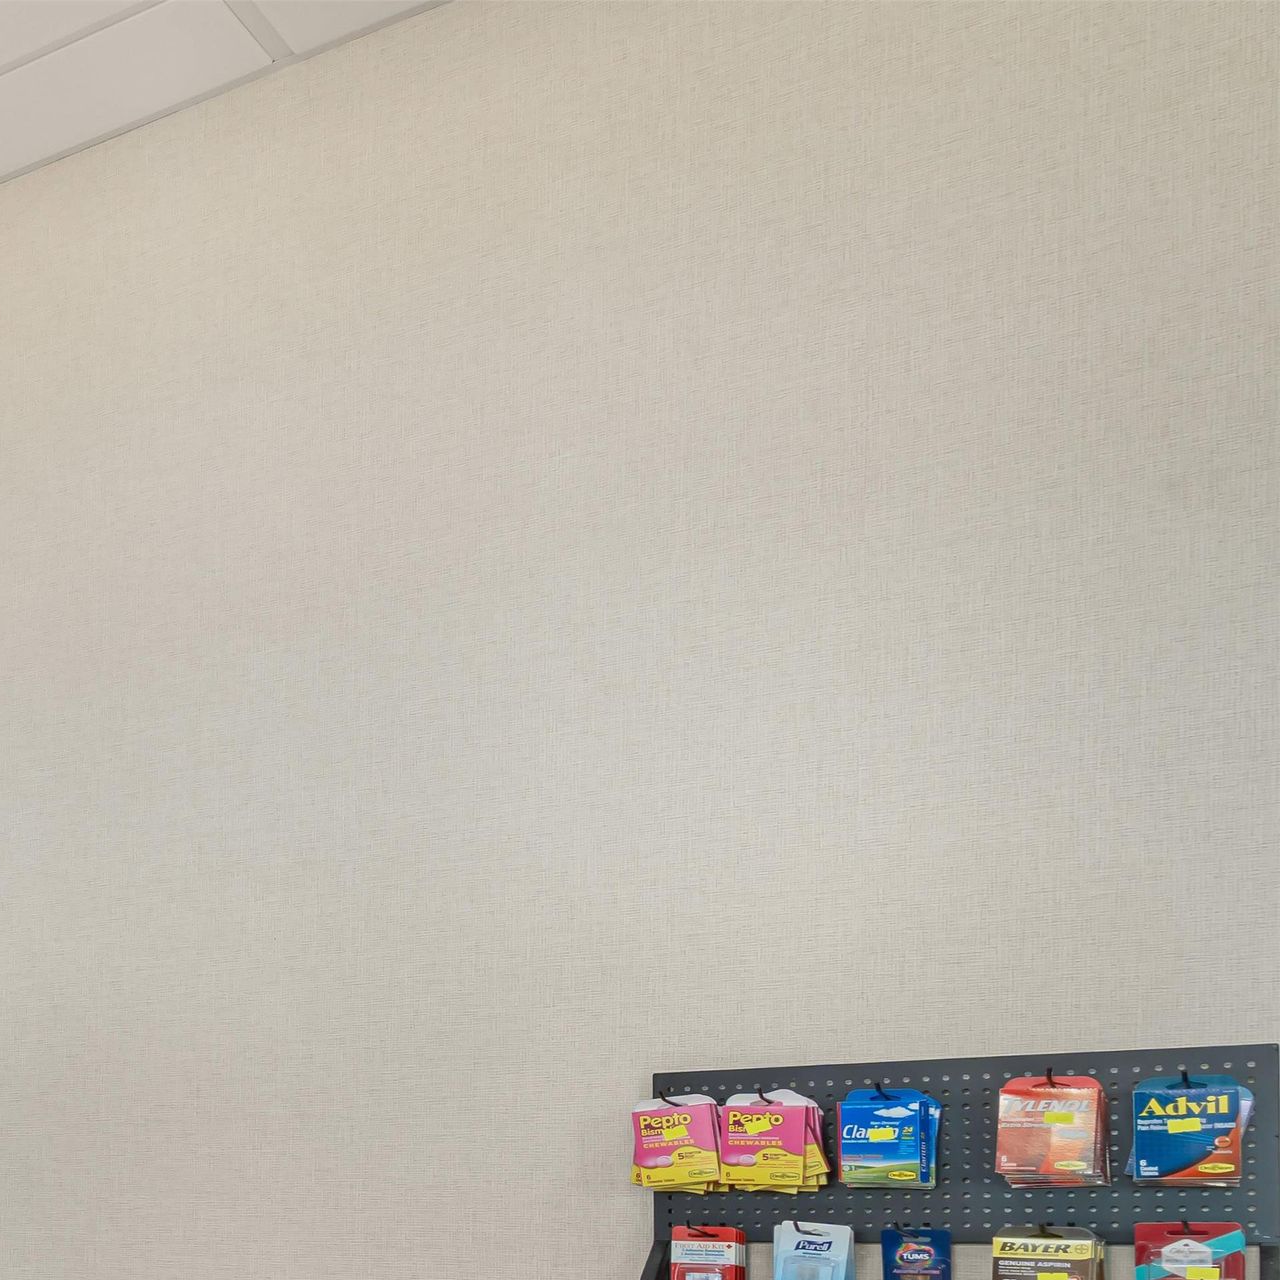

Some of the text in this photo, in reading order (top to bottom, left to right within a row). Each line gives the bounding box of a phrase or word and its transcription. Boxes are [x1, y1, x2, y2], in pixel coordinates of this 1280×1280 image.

[1003, 1099, 1089, 1114] TYLENOL
[1138, 1095, 1229, 1116] Advil
[640, 1113, 692, 1129] Pepto
[729, 1111, 784, 1125] Pepto
[843, 1125, 899, 1138] Clan
[643, 1139, 695, 1149] CHEWABLES
[799, 1240, 829, 1250] Purell
[1000, 1241, 1071, 1253] BAYER
